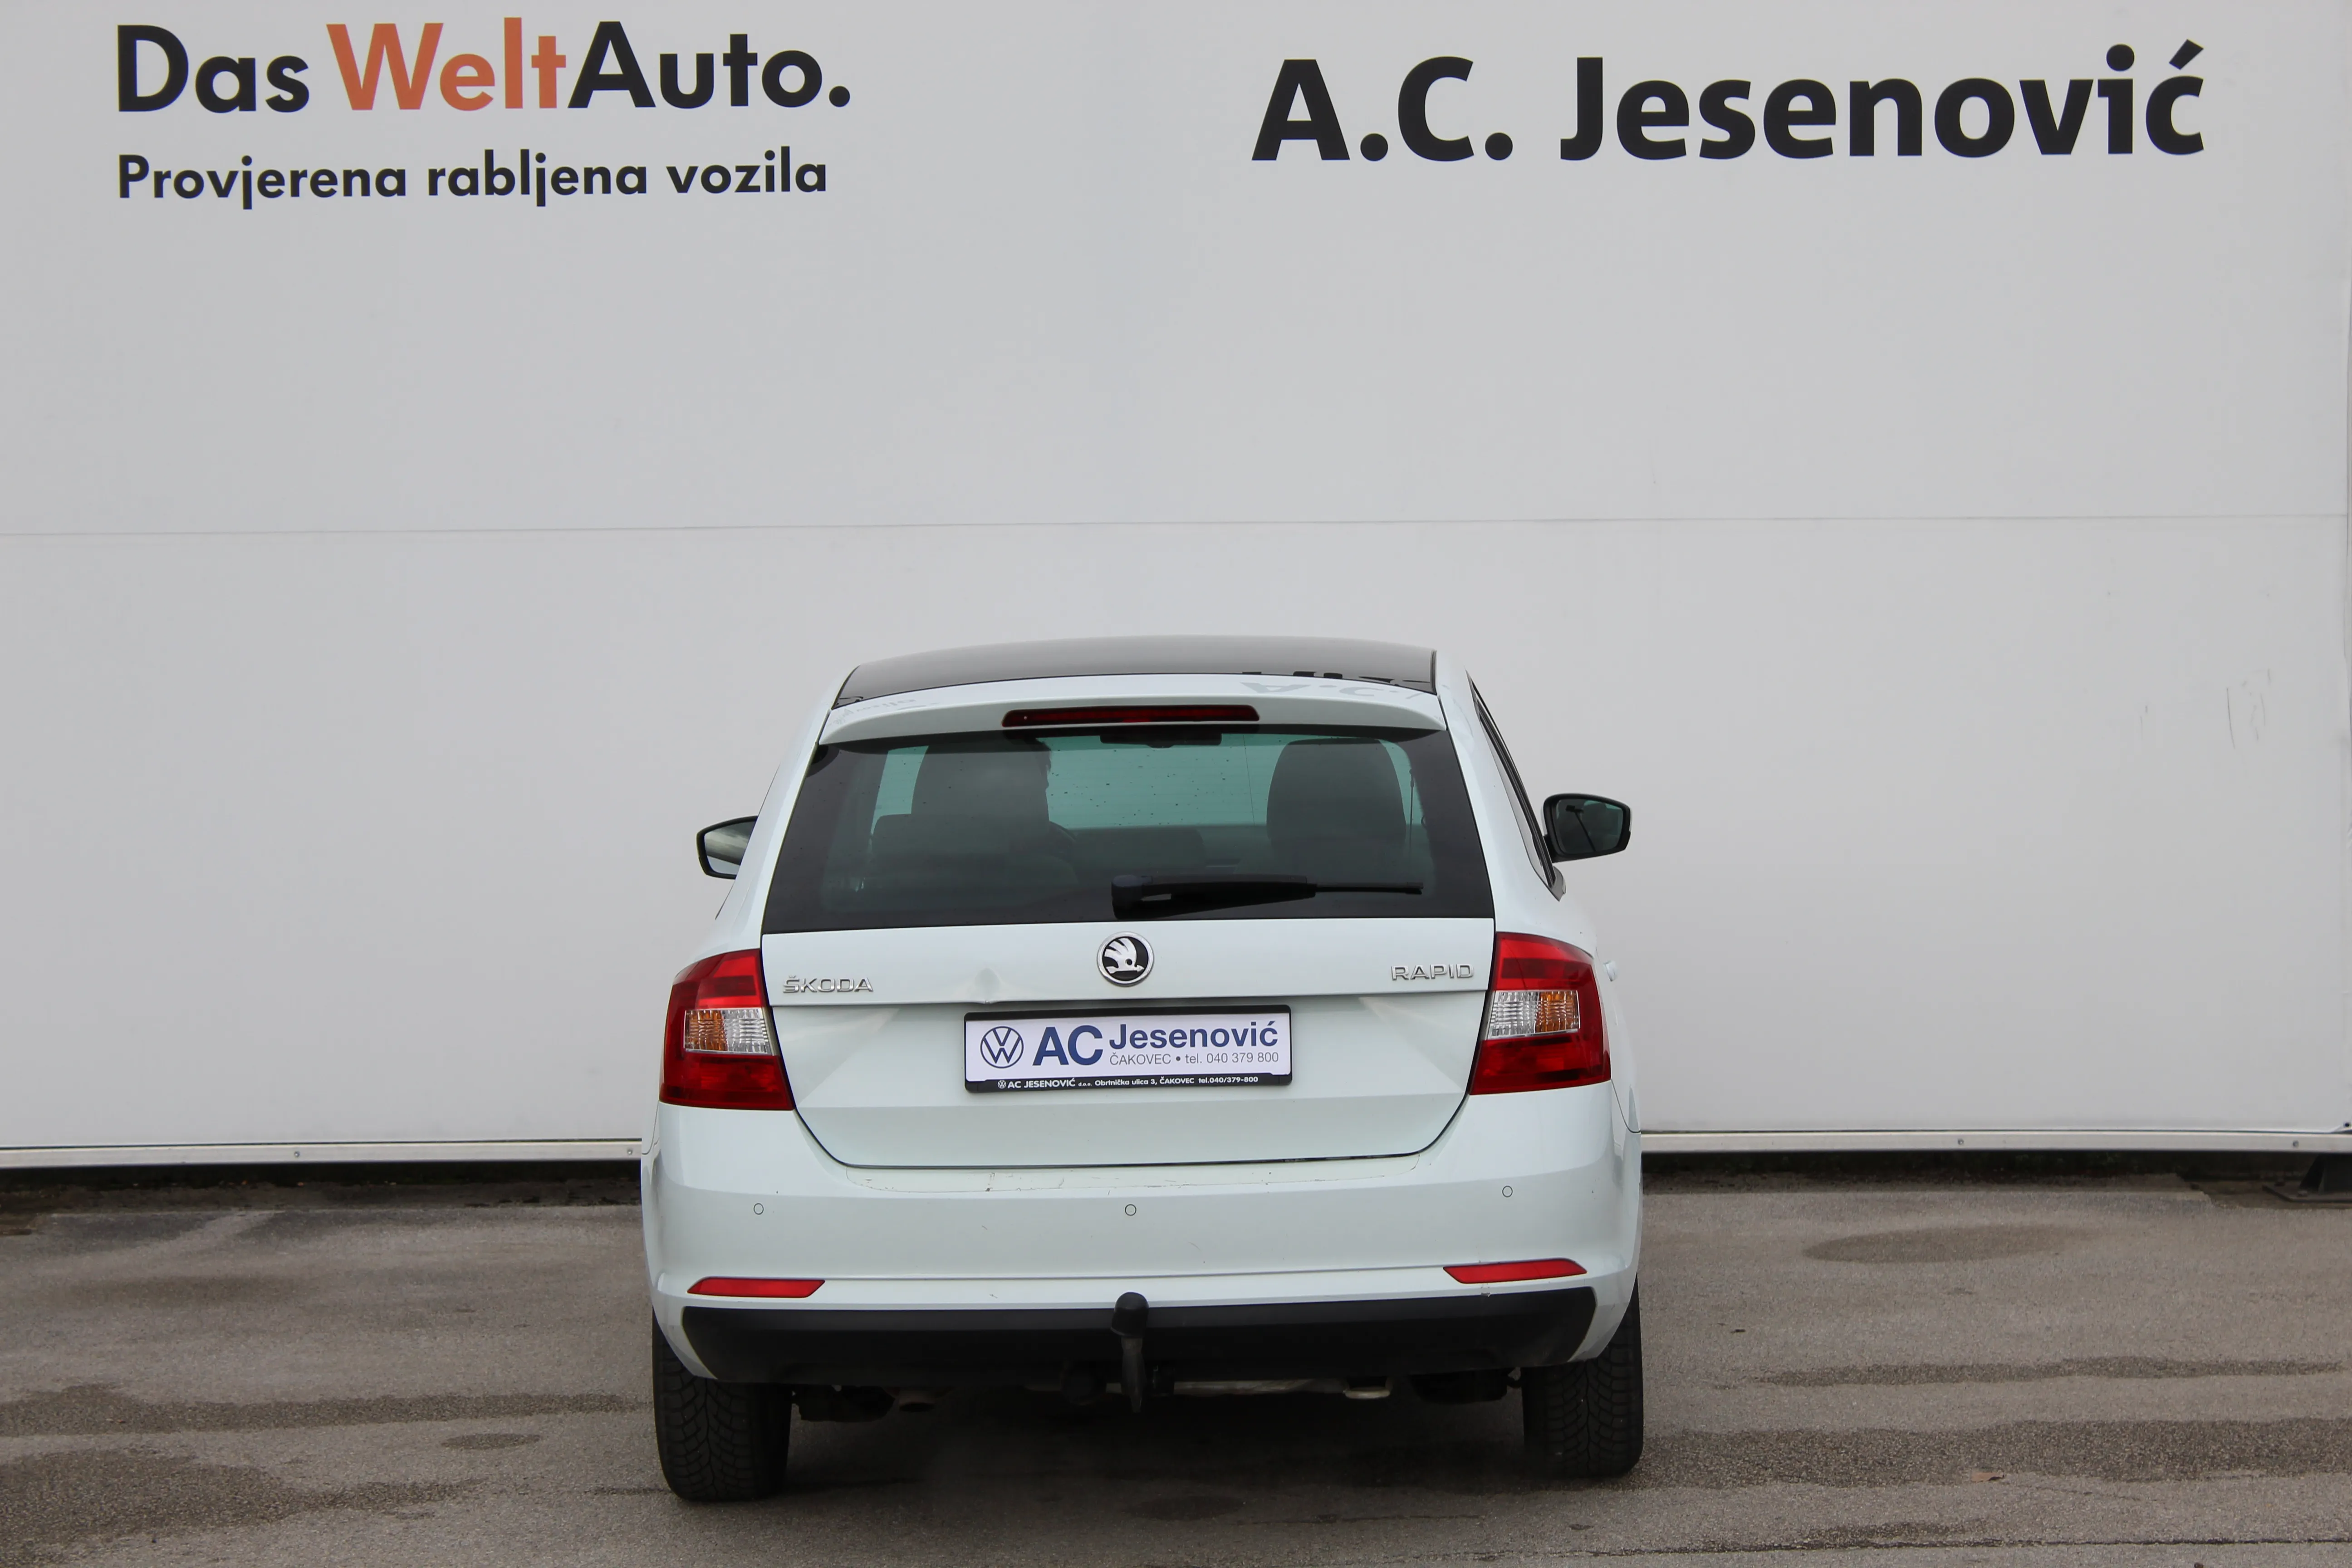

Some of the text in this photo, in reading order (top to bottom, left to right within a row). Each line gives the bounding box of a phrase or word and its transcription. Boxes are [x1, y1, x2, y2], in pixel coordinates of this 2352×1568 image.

[118, 25, 309, 113] Das
[1252, 39, 2204, 162] A.C. Jesenović
[119, 146, 826, 210] Provjerena rabljena vozila
[783, 975, 873, 994] ŠKODA
[1391, 964, 1474, 980] RAPID
[1033, 1021, 1278, 1066] AC Jesenović
[1110, 1052, 1279, 1065] ČAKOVEC tel. 040 379 800
[1024, 1078, 1076, 1088] JESENOVIĆ
[1159, 1076, 1195, 1084] ČAKOVEC
